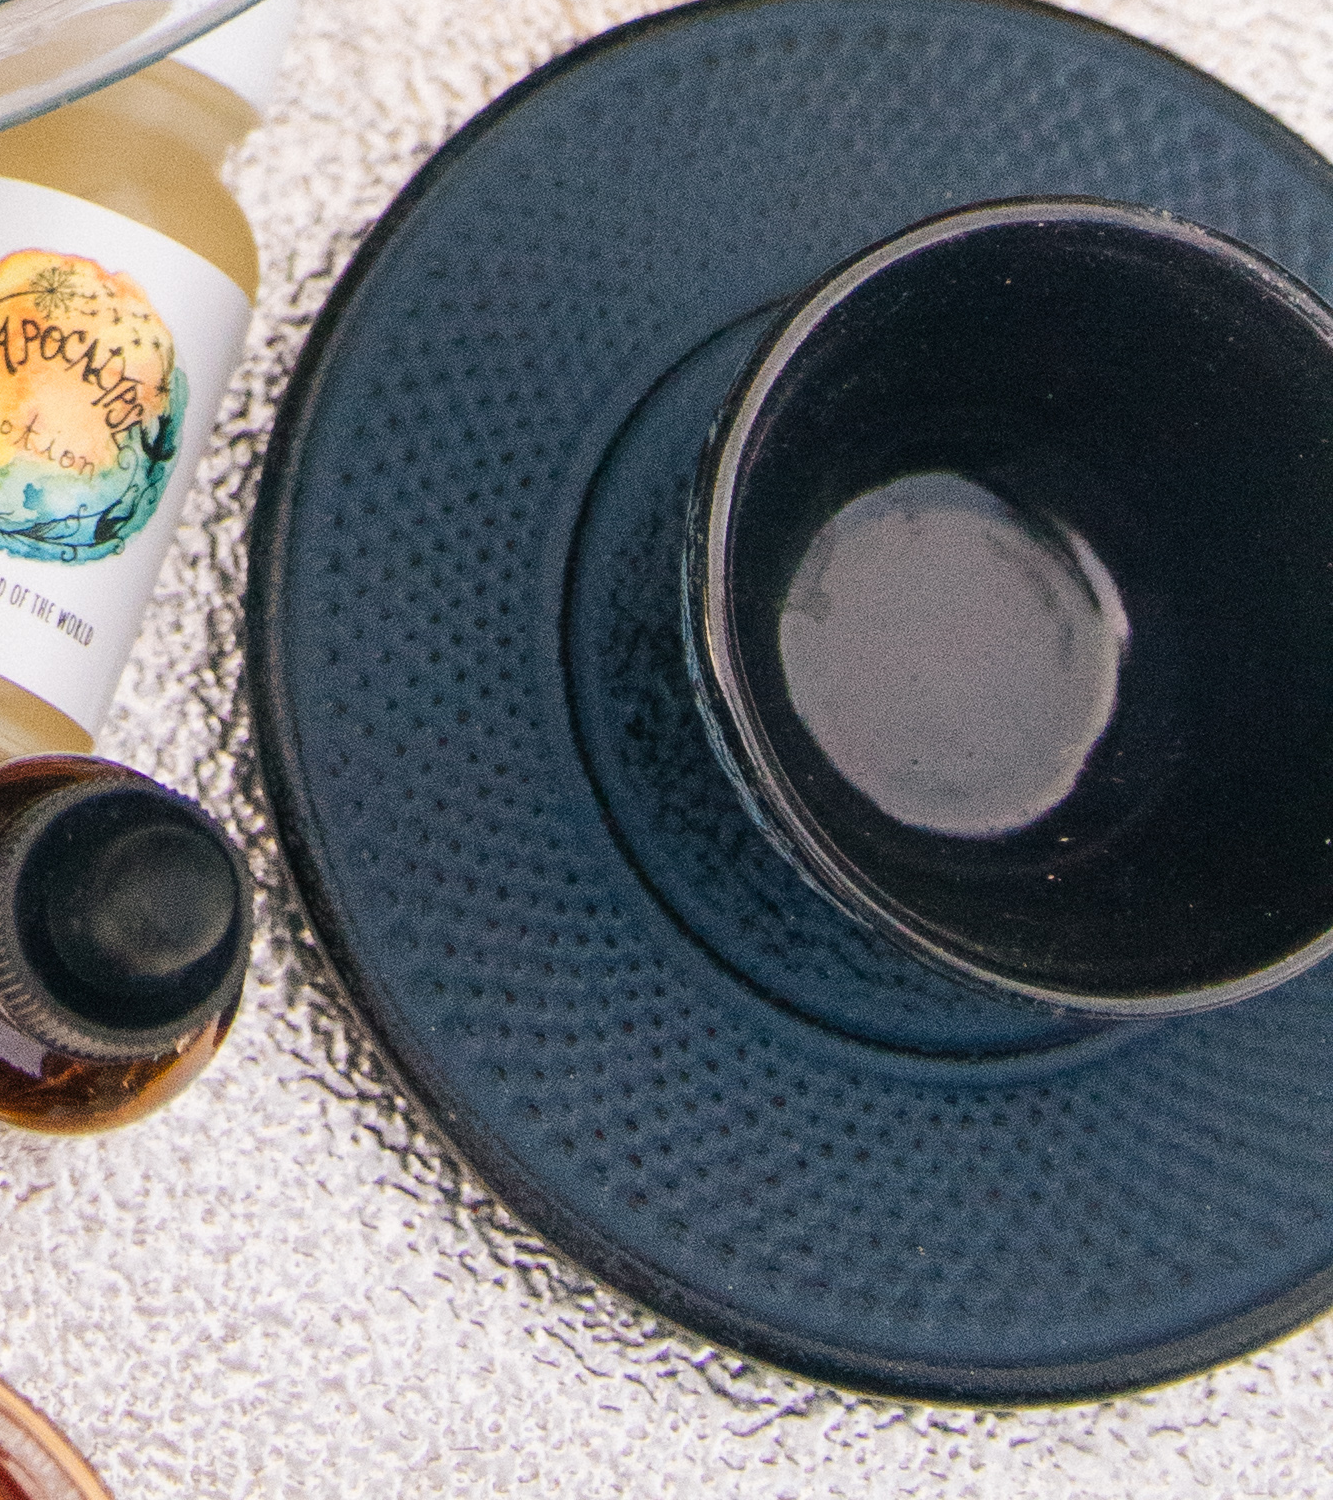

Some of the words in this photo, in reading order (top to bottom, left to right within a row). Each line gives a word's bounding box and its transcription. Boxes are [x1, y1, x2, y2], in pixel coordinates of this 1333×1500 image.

[9, 584, 32, 608] OF
[30, 593, 57, 624] THE
[56, 608, 95, 647] WORLD
